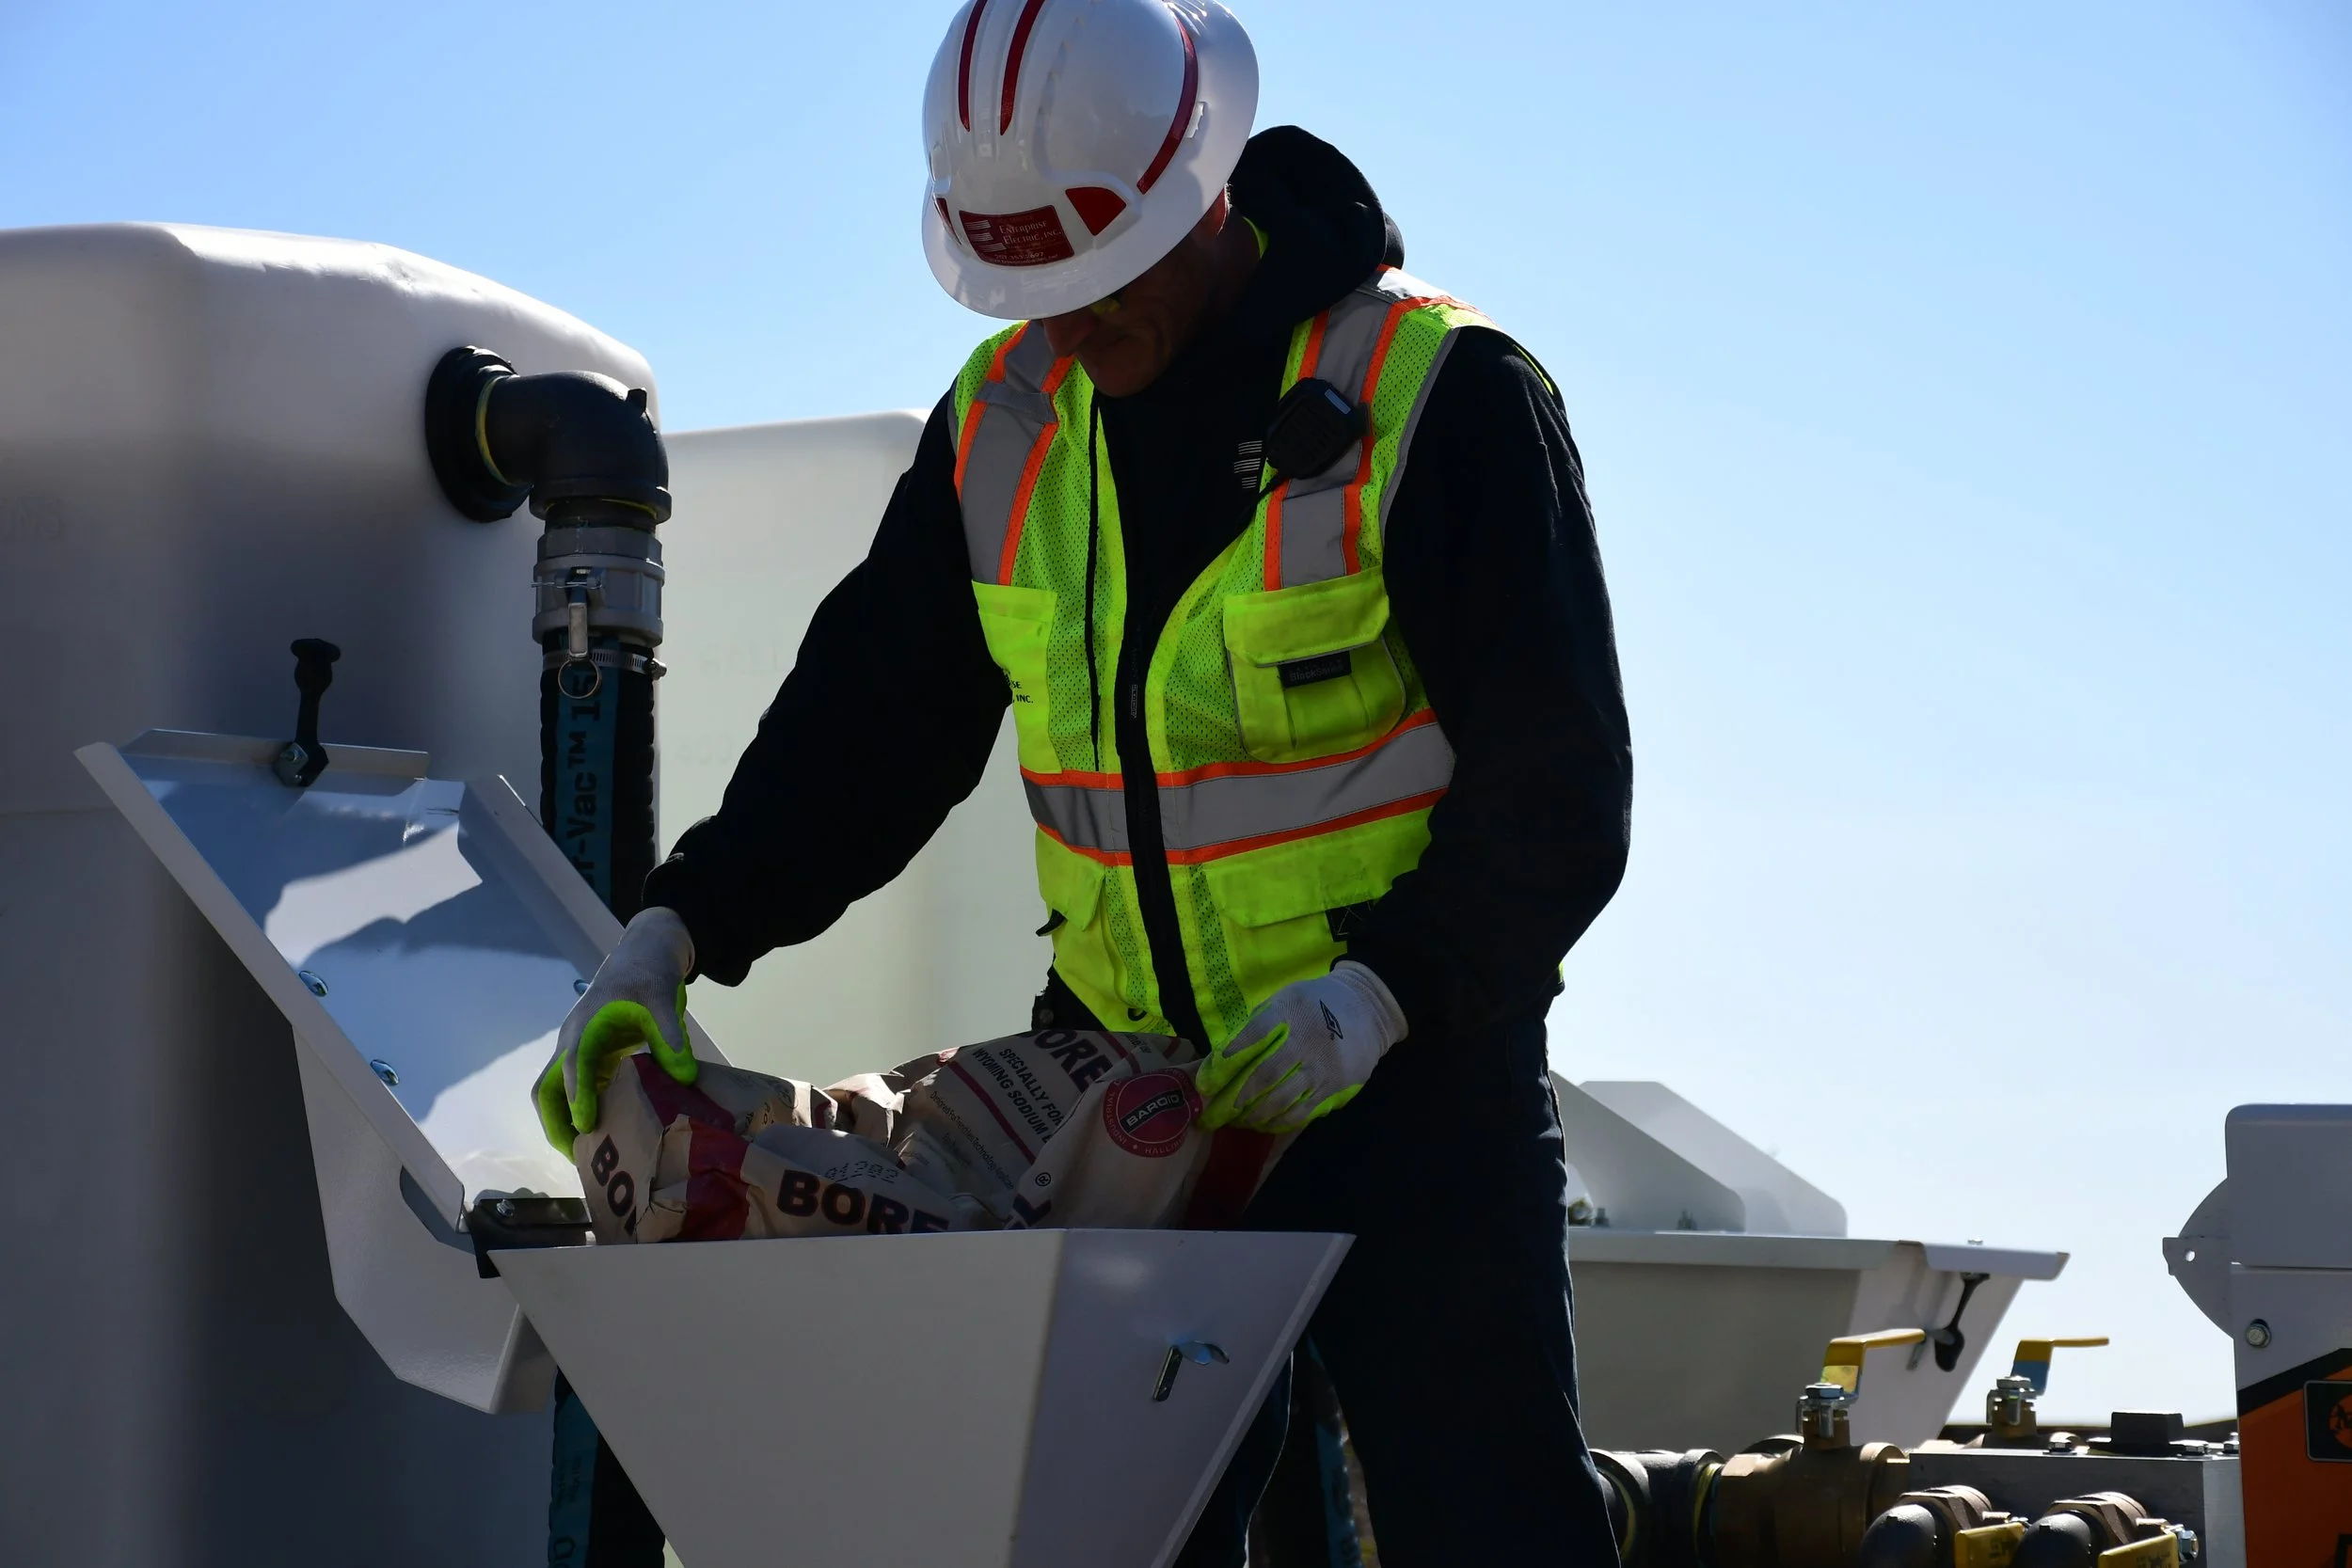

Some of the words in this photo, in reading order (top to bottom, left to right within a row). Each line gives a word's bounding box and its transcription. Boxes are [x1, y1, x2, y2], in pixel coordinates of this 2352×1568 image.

[973, 1048, 1013, 1091] WYOMING
[1007, 1089, 1046, 1135] SODIUM
[999, 1048, 1049, 1101] SPECIALLY
[1015, 1029, 1114, 1093] ORE
[1126, 1094, 1180, 1127] BAROID
[591, 1134, 637, 1237] BO
